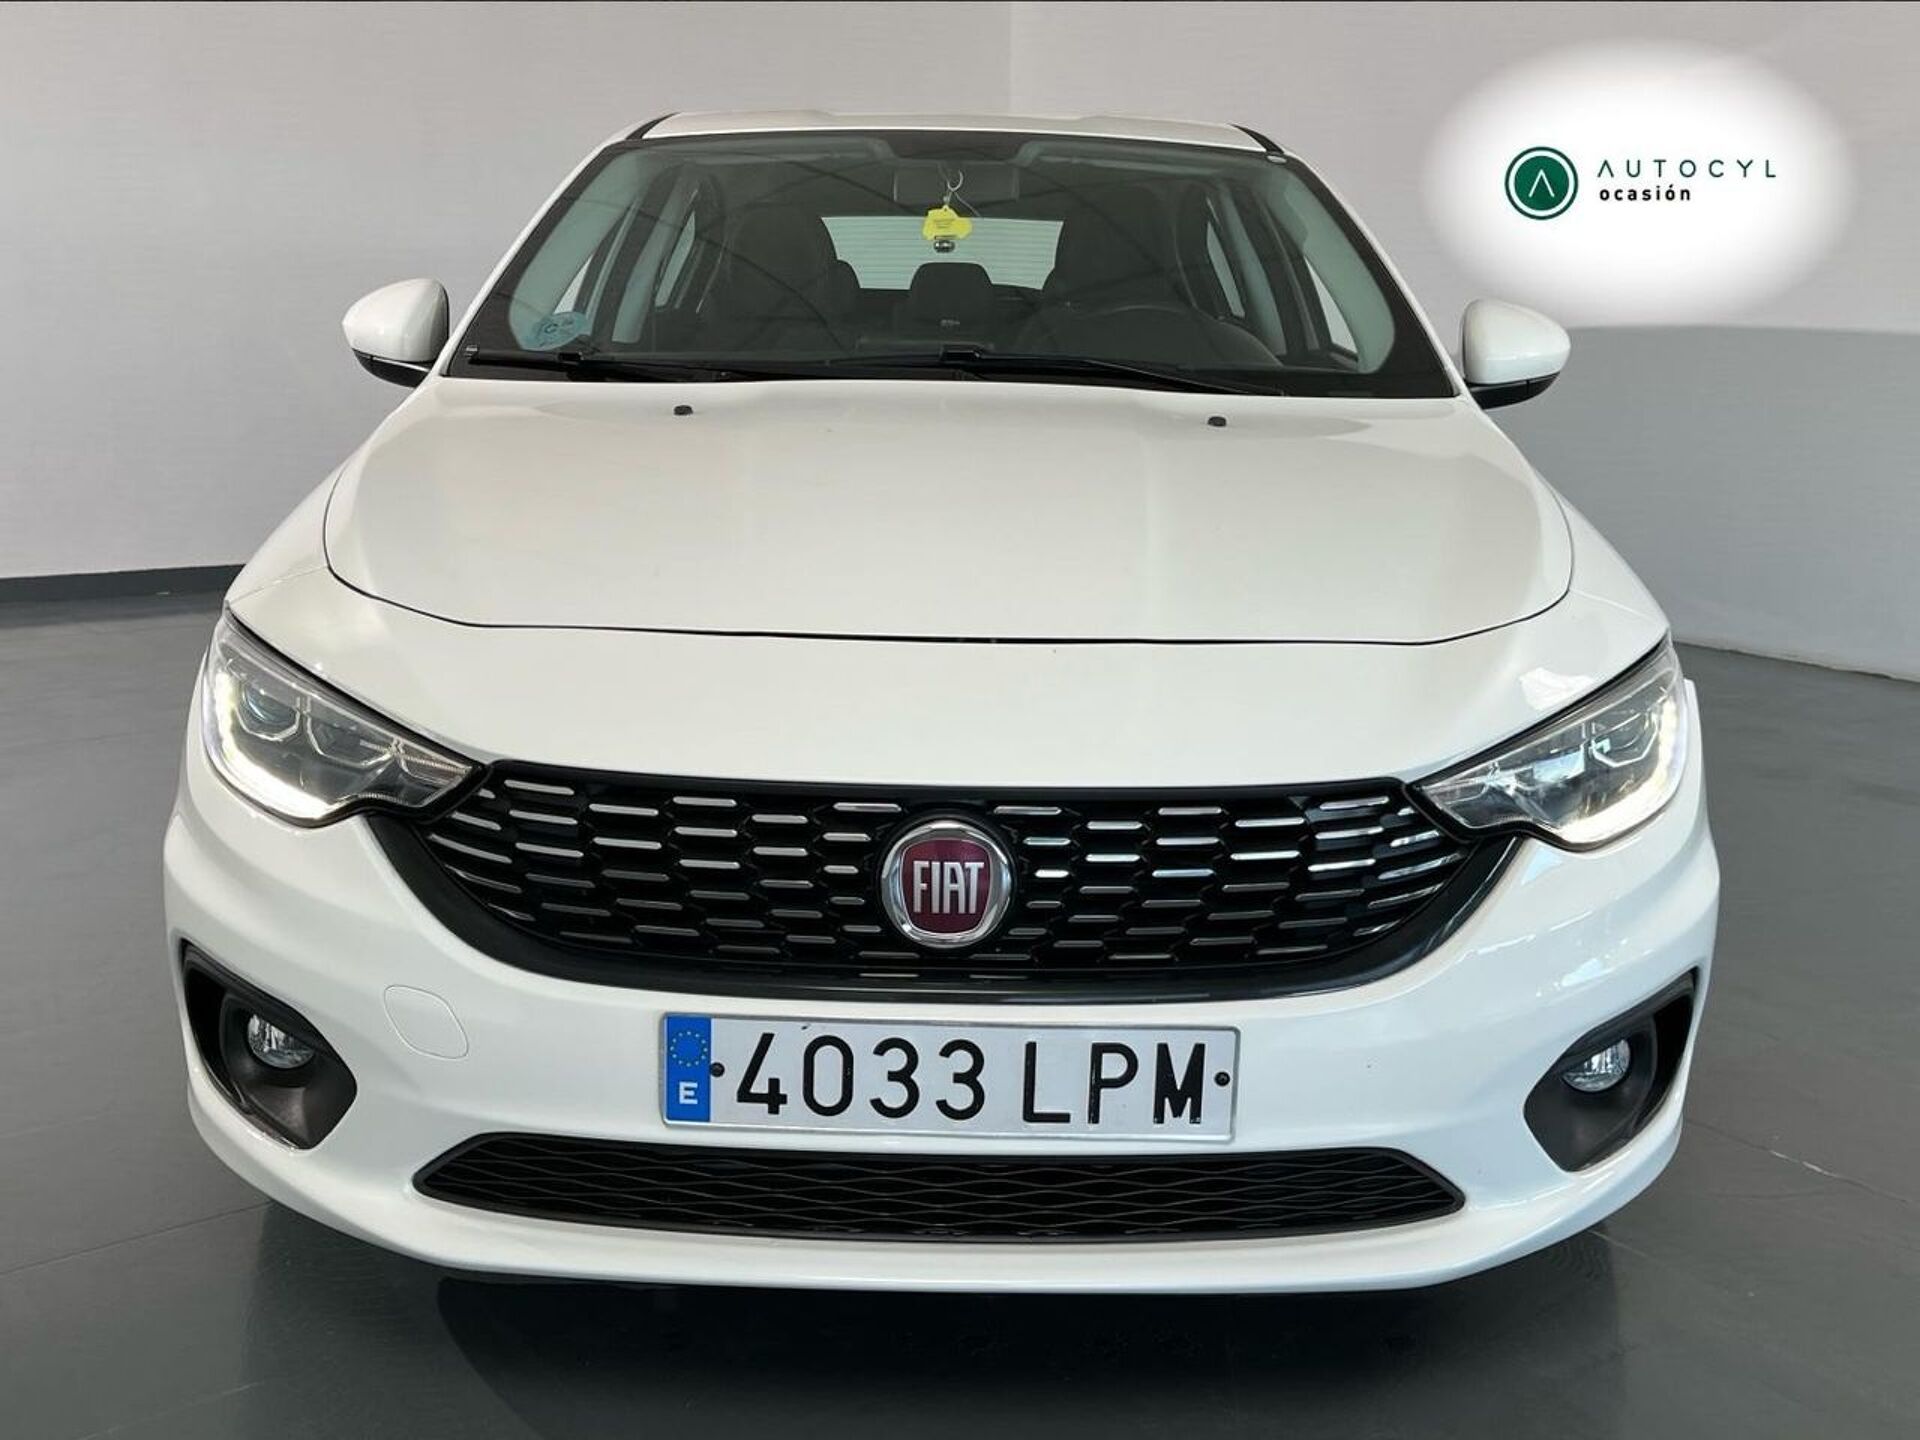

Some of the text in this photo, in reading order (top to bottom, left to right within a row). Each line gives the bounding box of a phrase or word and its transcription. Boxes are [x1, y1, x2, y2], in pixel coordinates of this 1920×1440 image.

[912, 860, 985, 915] FIAT
[678, 1081, 698, 1105] E
[735, 1032, 1206, 1125] 4033 LPM
